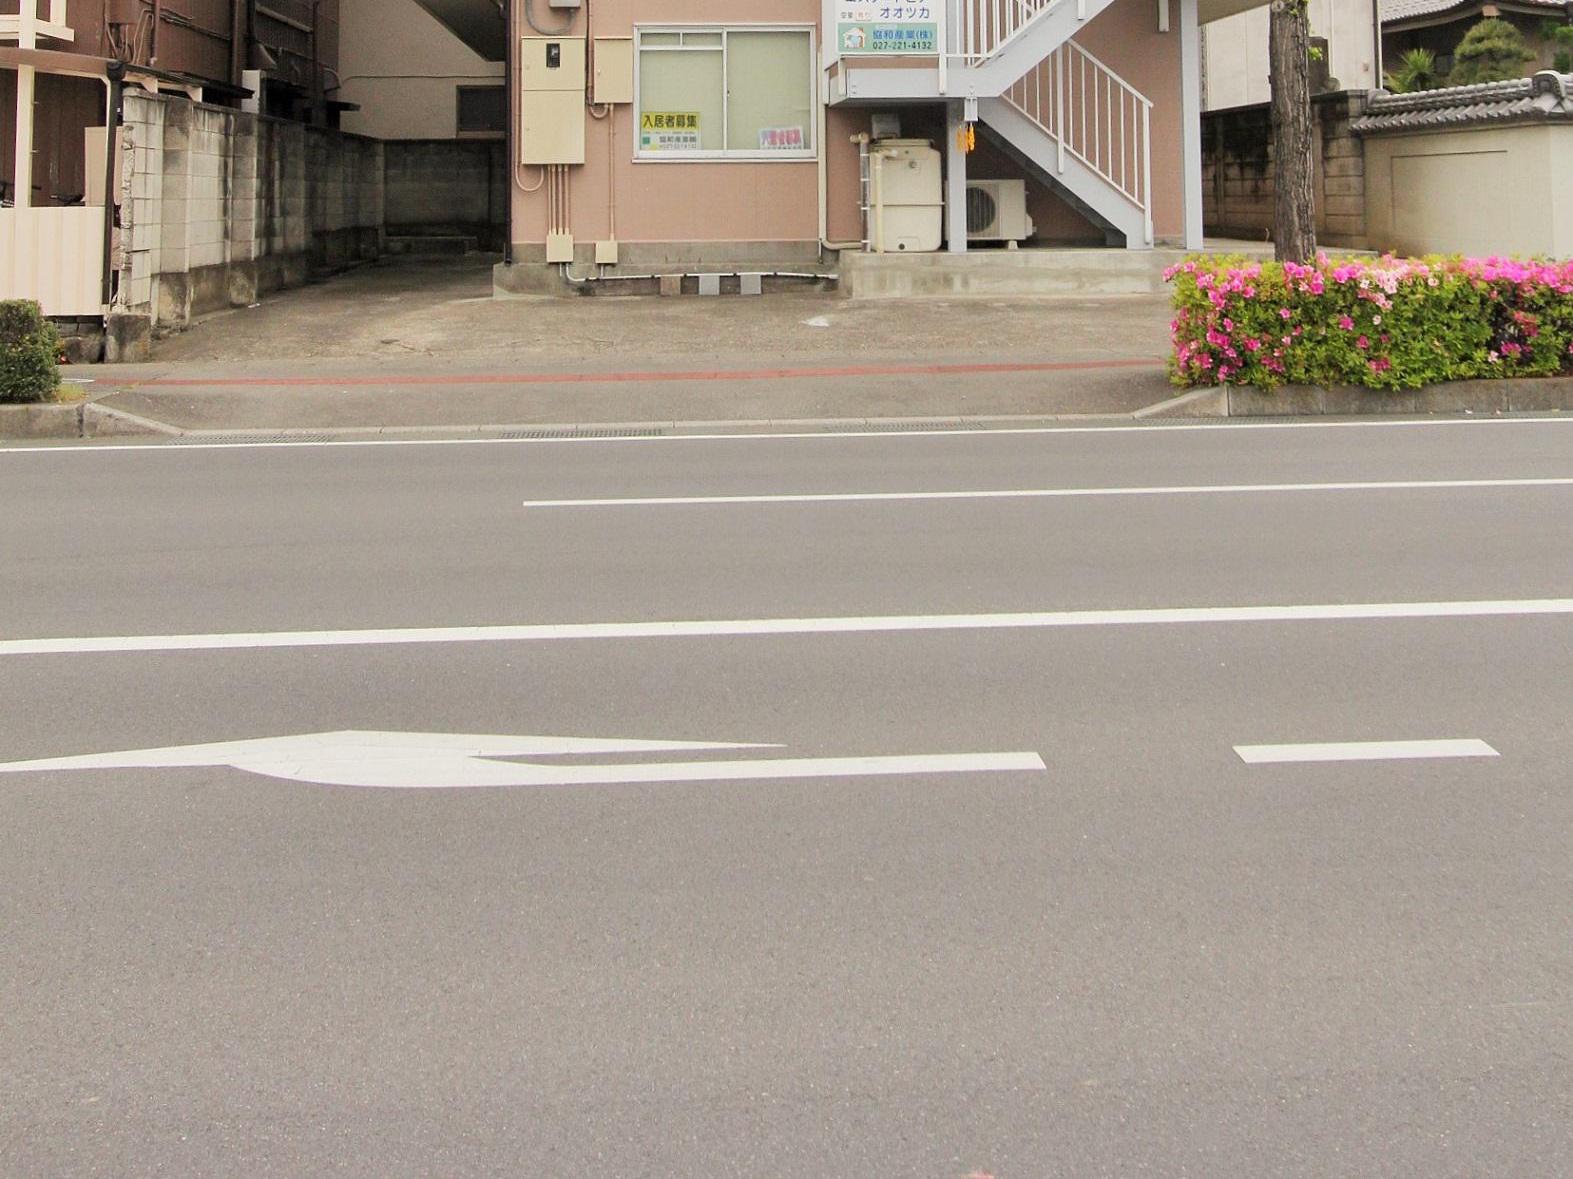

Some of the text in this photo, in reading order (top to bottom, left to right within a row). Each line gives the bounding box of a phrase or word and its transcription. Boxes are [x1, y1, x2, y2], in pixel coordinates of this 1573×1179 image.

[880, 6, 930, 19] オオツカ
[872, 42, 932, 50] 027-221-4132
[643, 114, 697, 128] 入居者募集
